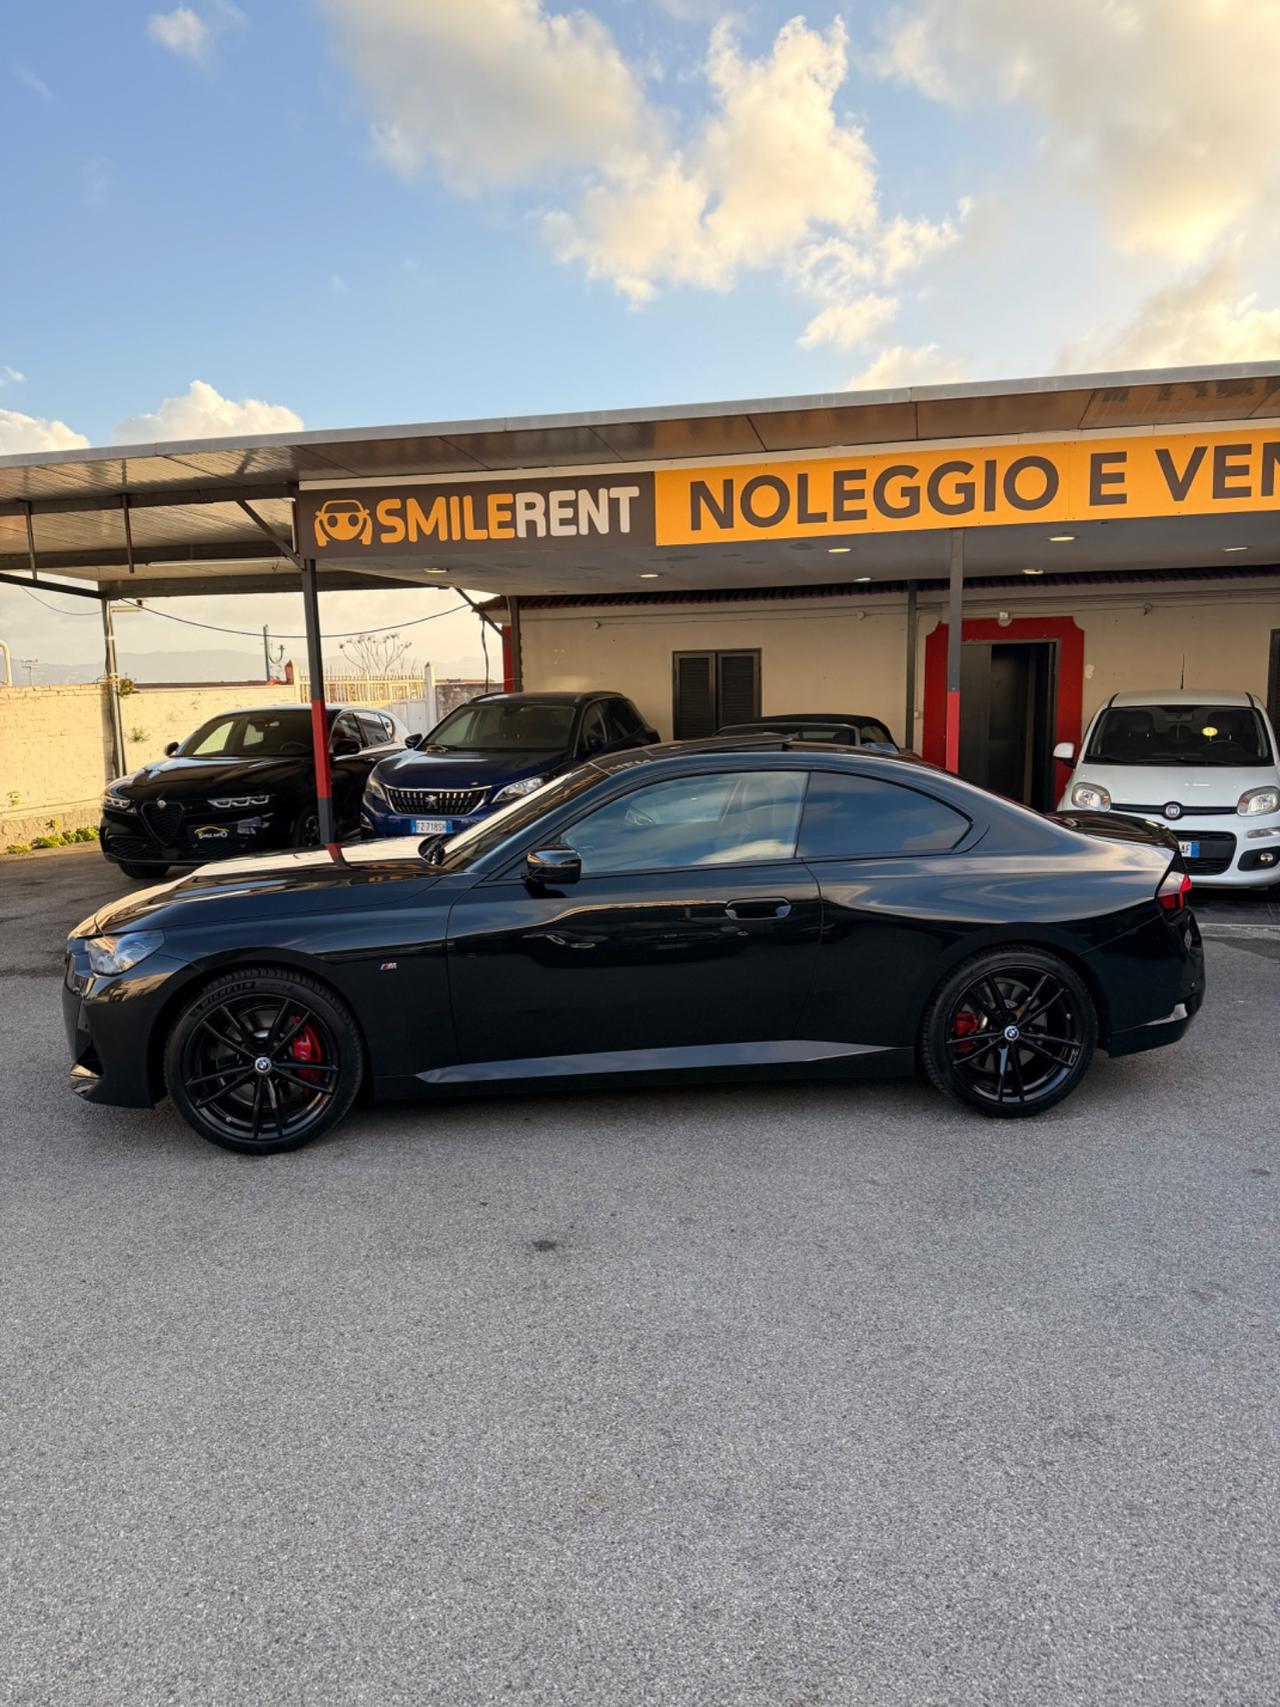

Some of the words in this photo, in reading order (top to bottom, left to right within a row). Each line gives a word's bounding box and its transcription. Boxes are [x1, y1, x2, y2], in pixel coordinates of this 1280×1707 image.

[376, 486, 640, 544] SMILERENT
[690, 456, 1060, 531] NOLEGGIO
[1089, 451, 1128, 506] E
